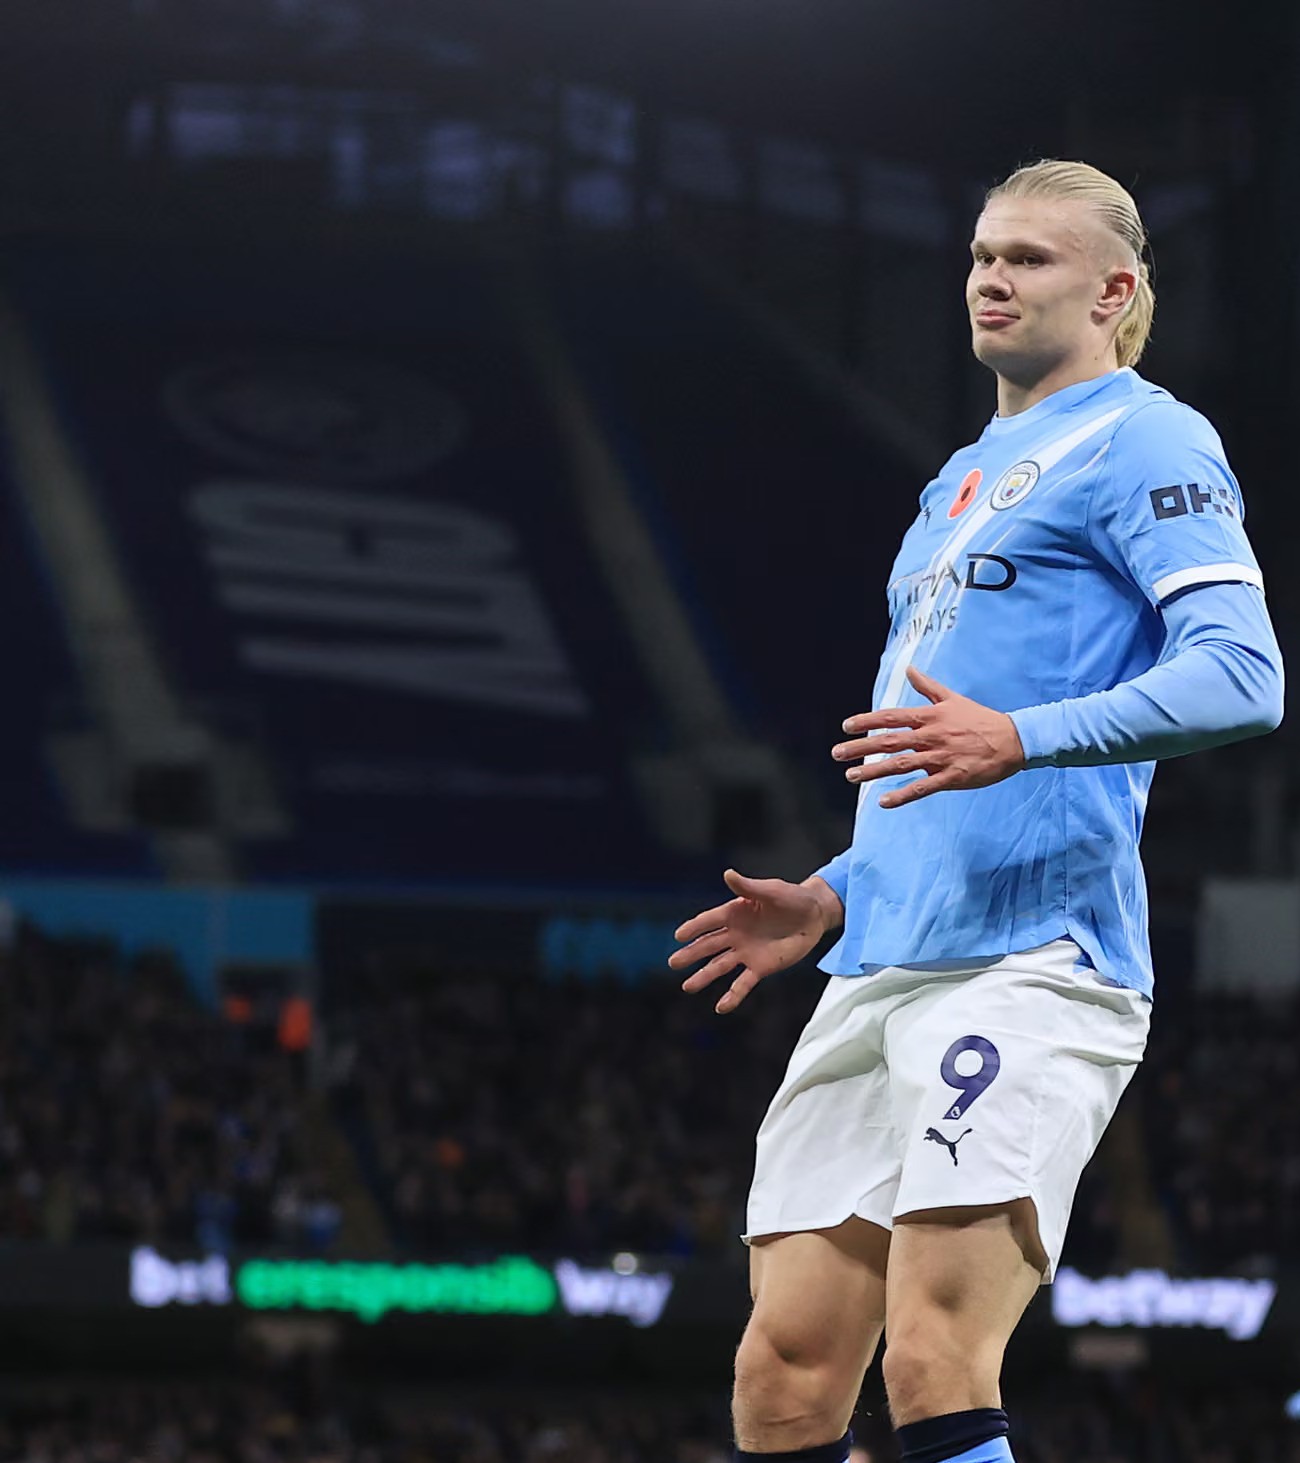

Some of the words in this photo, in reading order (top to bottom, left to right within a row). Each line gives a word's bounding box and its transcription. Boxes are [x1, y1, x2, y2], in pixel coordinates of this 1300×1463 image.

[895, 606, 958, 643] WAYS
[940, 1035, 1001, 1120] 9
[1052, 1267, 1277, 1340] betway
